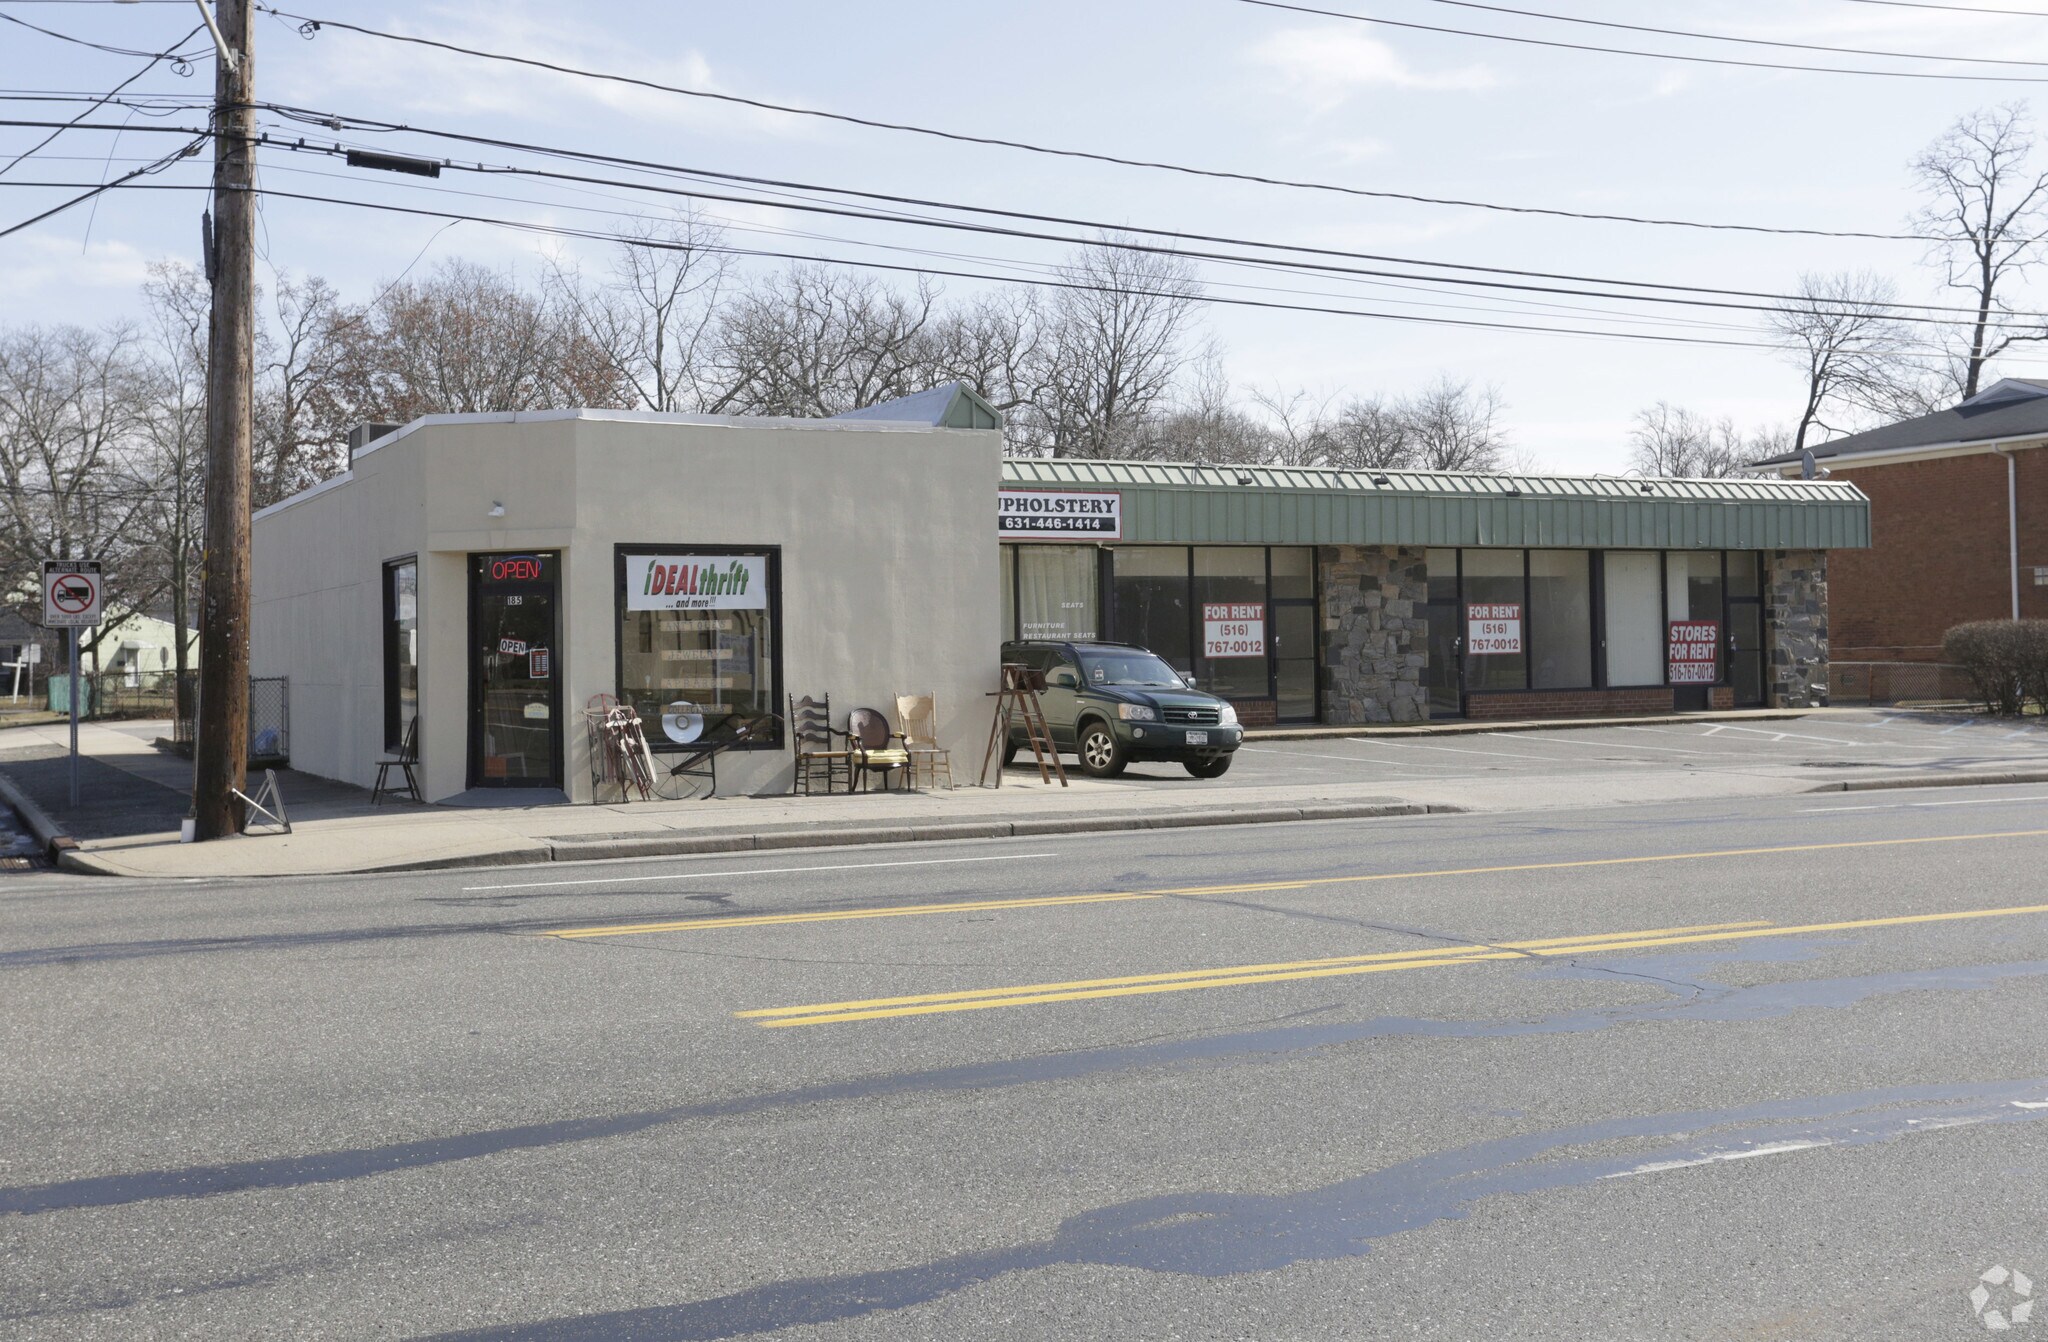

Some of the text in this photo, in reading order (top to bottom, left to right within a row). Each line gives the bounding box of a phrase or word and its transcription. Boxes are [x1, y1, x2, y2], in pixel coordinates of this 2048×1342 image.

[998, 498, 1115, 513] PHOLSTERY
[1005, 518, 1100, 529] 631-446-1414
[492, 561, 539, 579] OPEN
[507, 596, 522, 605] 185
[676, 597, 690, 608] and
[1205, 606, 1262, 619] FOR RENT
[1468, 606, 1519, 618] FOR RENT
[1220, 624, 1248, 636] (516)
[1482, 623, 1507, 634] (516)
[1670, 625, 1716, 641] STORES
[501, 640, 526, 653] OPEN
[1207, 640, 1262, 653] 767-0012
[1471, 638, 1519, 650] 767-0012
[1669, 643, 1715, 660] FOR RENT
[1669, 664, 1714, 679] 516-767-0012
